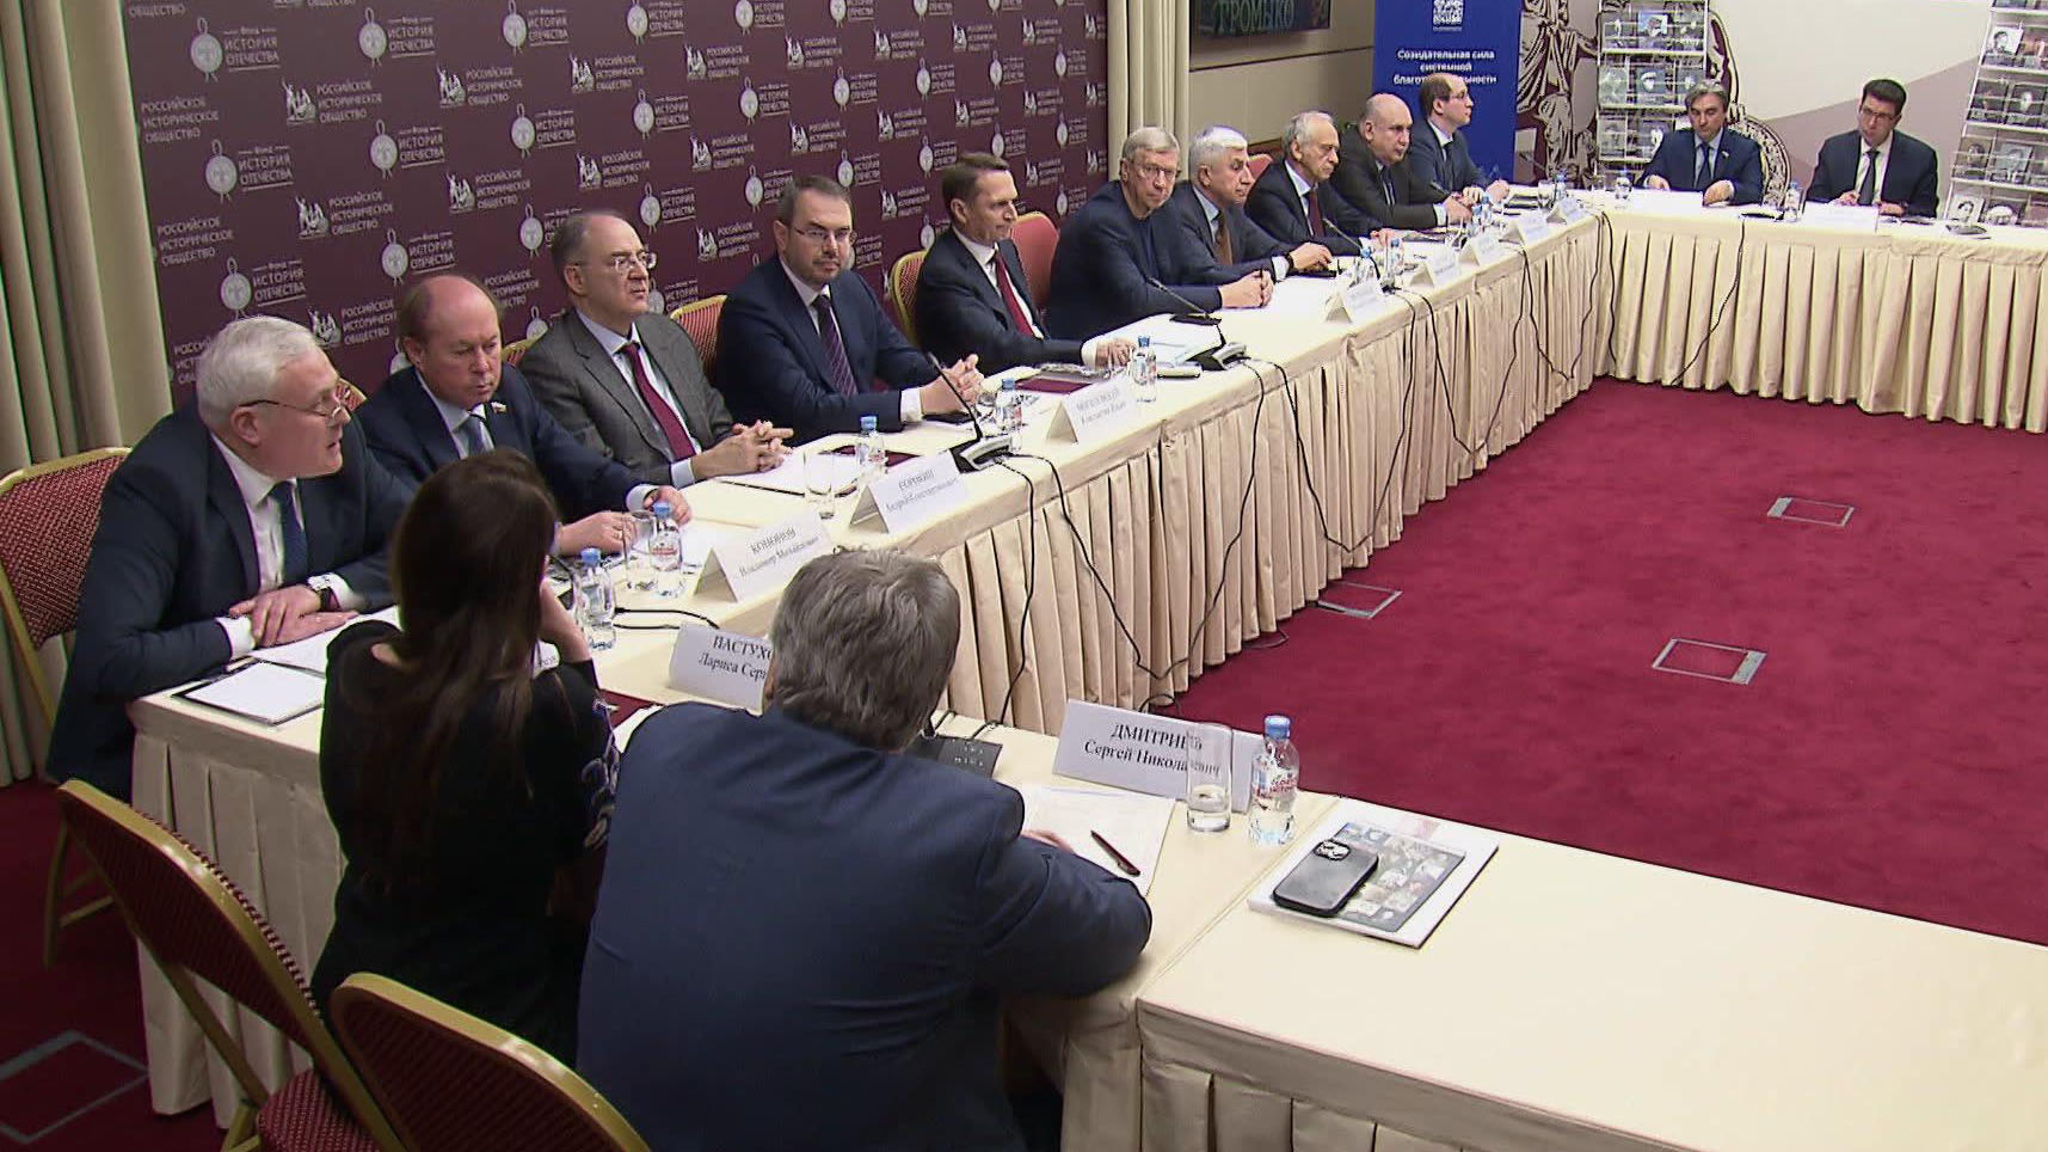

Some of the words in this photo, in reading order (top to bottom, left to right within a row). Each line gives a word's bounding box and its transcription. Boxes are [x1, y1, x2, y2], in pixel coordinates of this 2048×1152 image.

[527, 16, 567, 28] ИСТОРИЯ
[387, 25, 433, 38] ИСТОРИЯ
[528, 28, 568, 40] ОТЕЧЕСТВА
[224, 36, 278, 51] ИСТОРИЯ
[389, 38, 434, 51] ОТЕЧЕСТВА
[225, 50, 279, 65] ОТЕЧЕСТВА
[1472, 50, 1495, 59] сила
[316, 80, 371, 95] РОССИЙСКОЕ
[140, 97, 205, 113] РОССИЙСКОЕ
[318, 93, 382, 108] ИСТОРИЧЕСКОЕ
[142, 110, 218, 128] ИСТОРИЧЕСКОЕ
[319, 108, 367, 122] ОБЩЕСТВО
[535, 116, 574, 131] ИСТОРИЯ
[144, 127, 201, 143] ОБЩЕСТВО
[398, 134, 443, 149] ИСТОРИЯ
[536, 128, 575, 143] ОТЕЧЕСТВА
[399, 146, 444, 162] ОТЕЧЕСТВА
[238, 154, 291, 171] ИСТОРИЯ
[239, 167, 292, 185] ОТЕЧЕСТВА
[328, 191, 382, 208] РОССИЙСКОЕ
[330, 203, 393, 221] ИСТОРИЧЕСКОЕ
[157, 217, 220, 236] РОССИЙСКОЕ
[331, 218, 378, 234] ОБЩЕСТВО
[159, 230, 233, 250] ИСТОРИЧЕСКОЕ
[409, 239, 453, 257] ИСТОРИЯ
[160, 247, 216, 265] ОБЩЕСТВО
[410, 251, 454, 269] ОТЕЧЕСТВА
[252, 268, 304, 288] ИСТОРИЯ
[254, 281, 305, 301] ОТЕЧЕСТВА
[341, 299, 394, 319] РОССИЙСКОЕ
[343, 326, 389, 345] ОБЩЕСТВО
[698, 652, 739, 673] Лариса
[1084, 739, 1132, 761] Сергей
